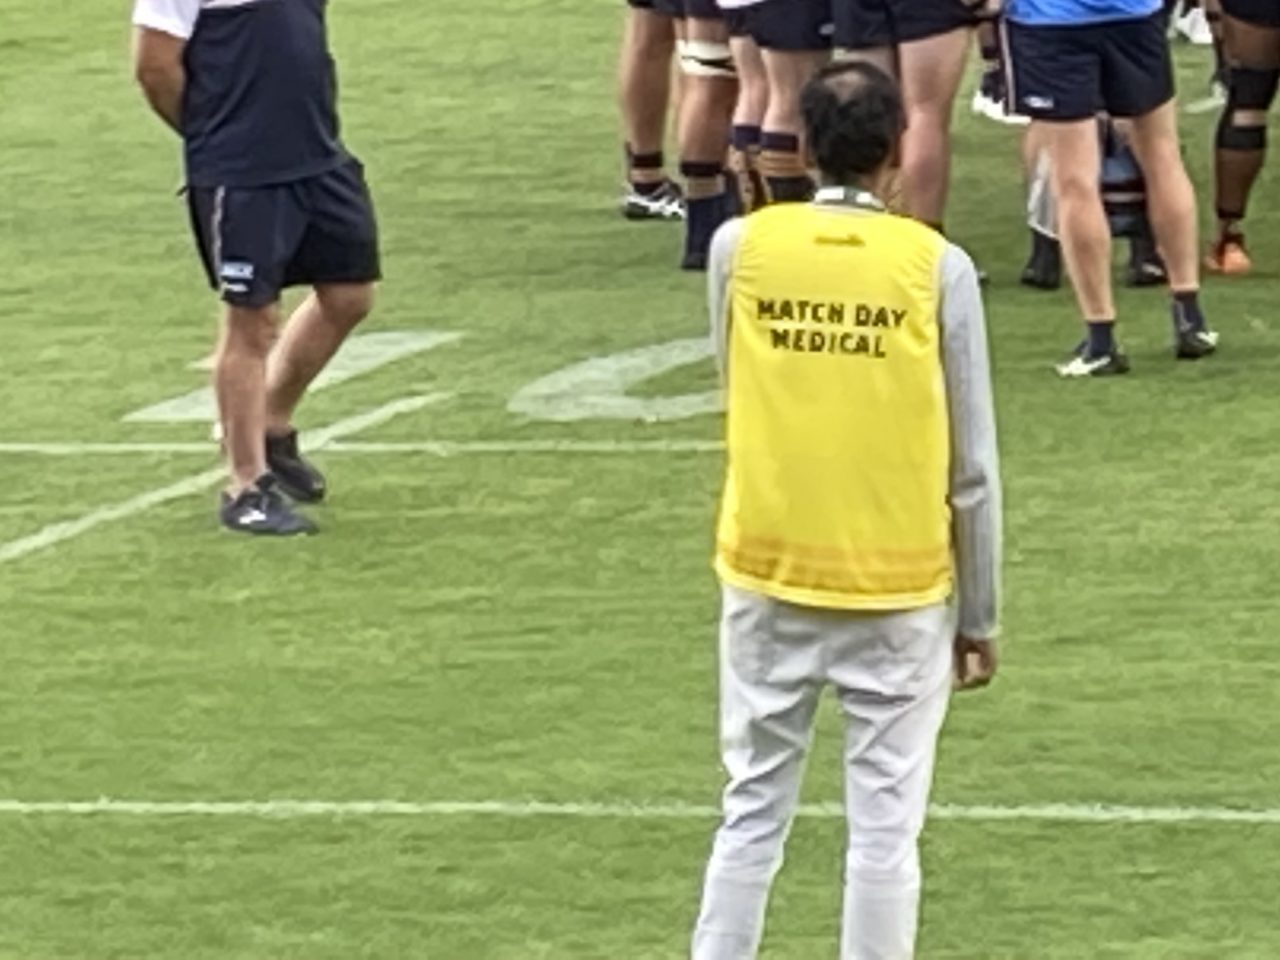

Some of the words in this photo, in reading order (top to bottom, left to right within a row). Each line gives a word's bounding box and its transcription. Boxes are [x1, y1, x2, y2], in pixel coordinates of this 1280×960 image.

[757, 300, 845, 324] MATCH
[854, 304, 908, 329] DAY
[769, 328, 887, 359] MEDICAL
